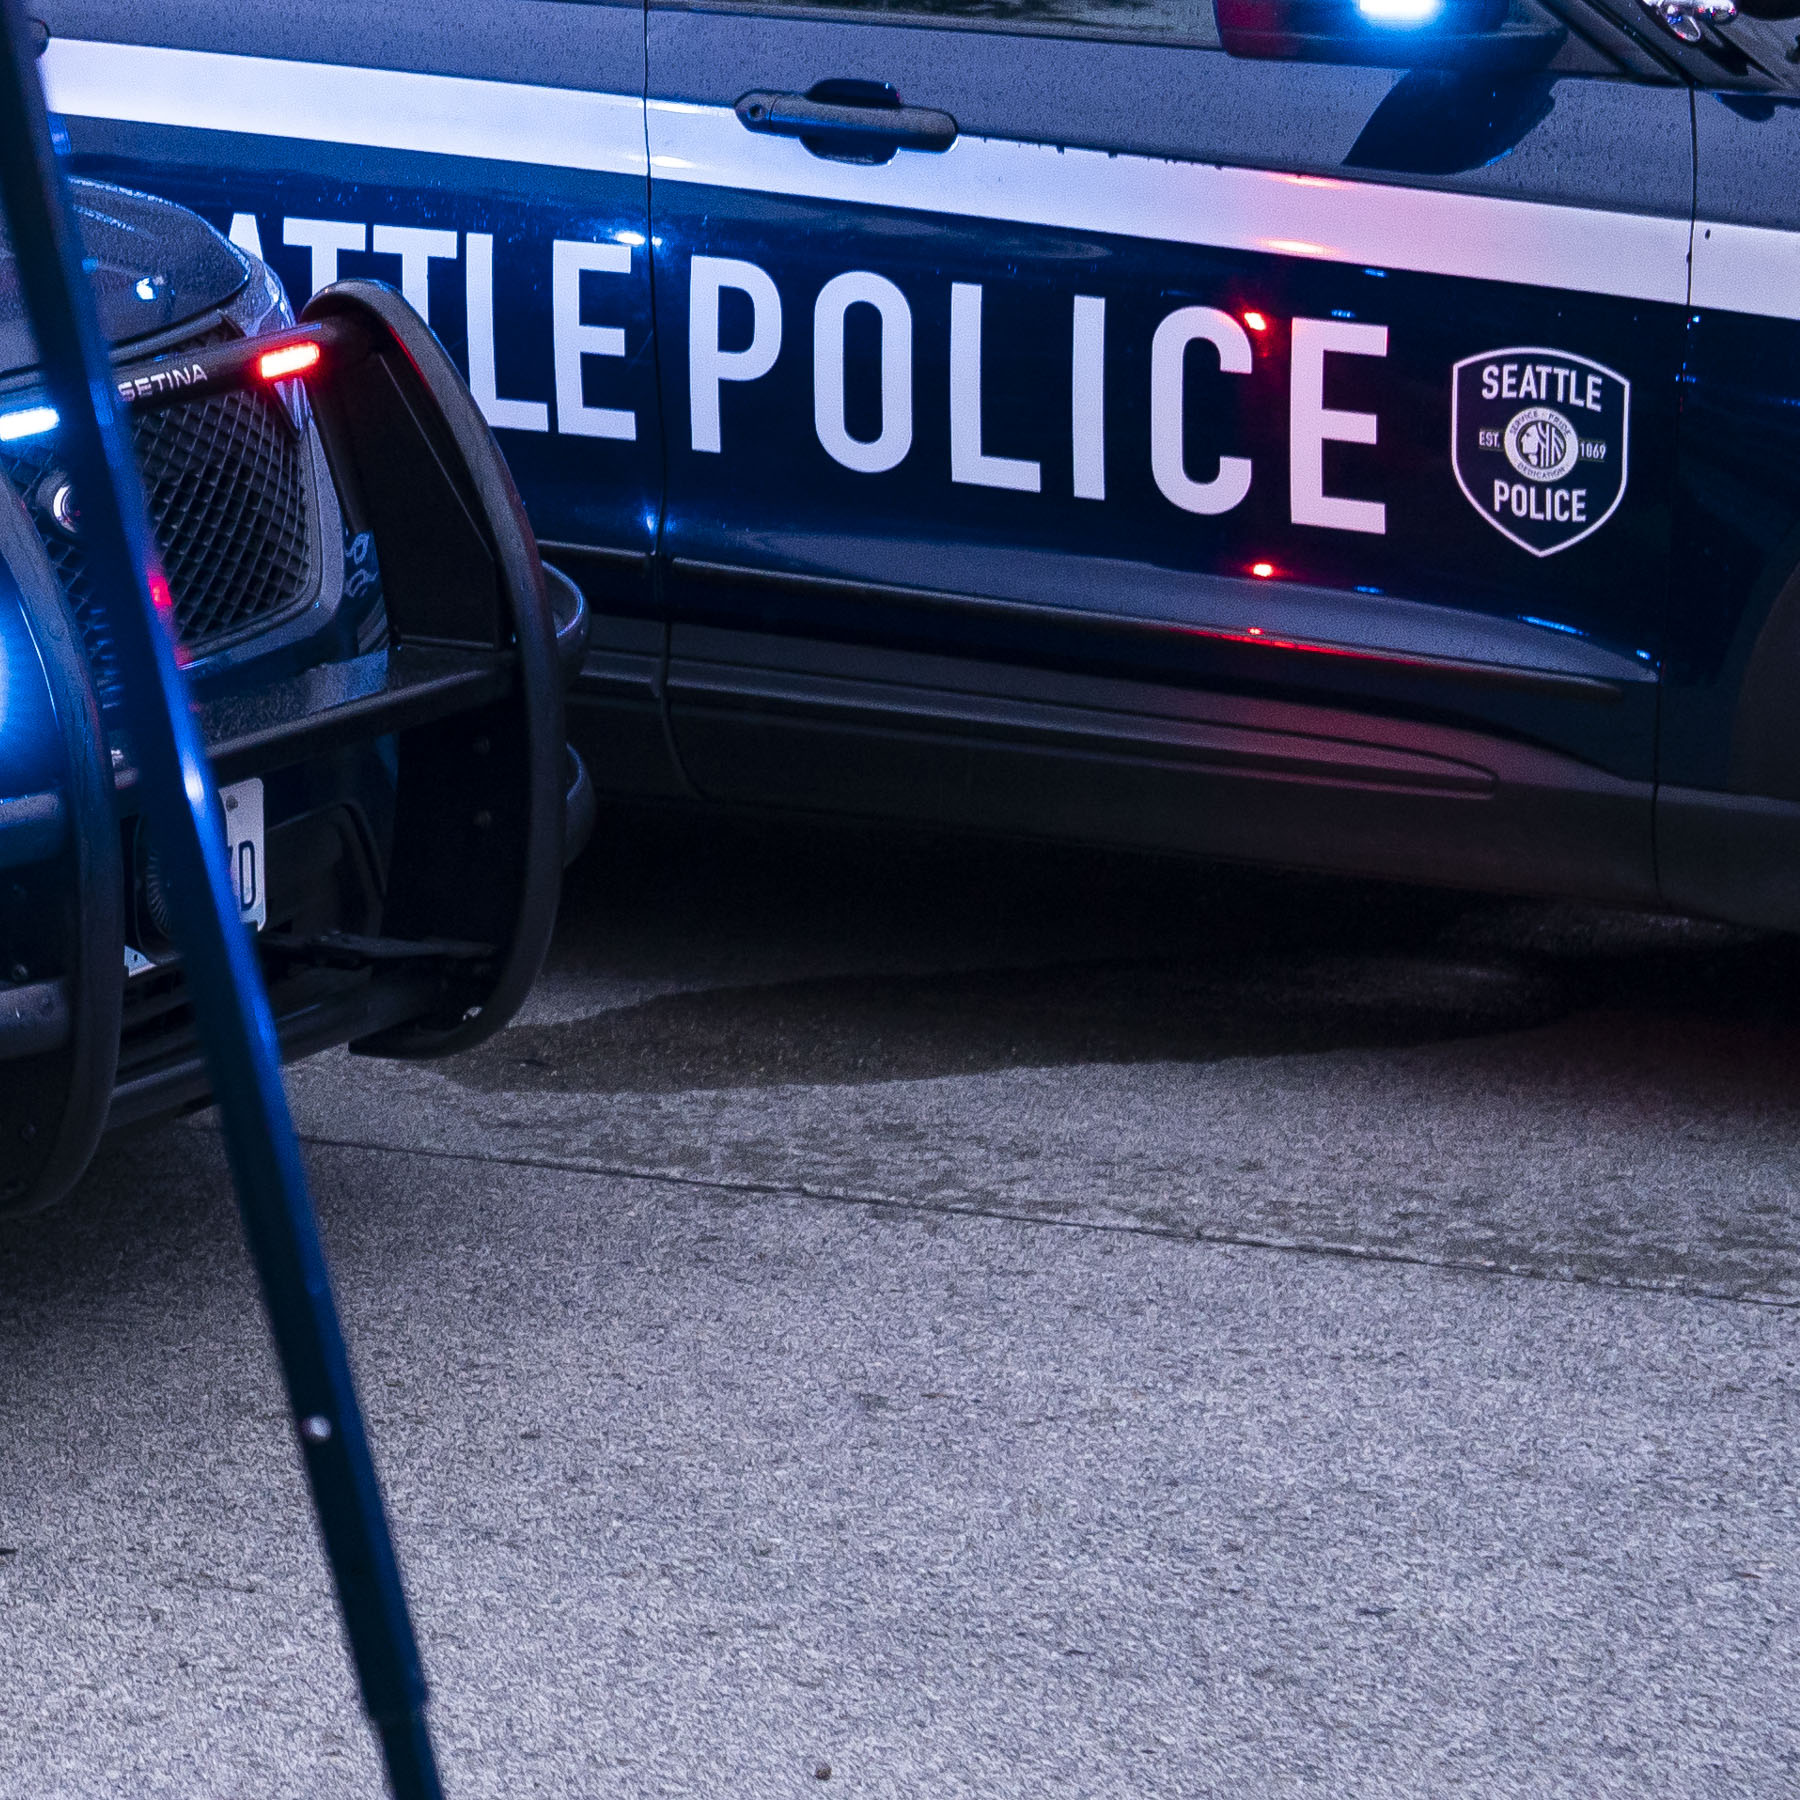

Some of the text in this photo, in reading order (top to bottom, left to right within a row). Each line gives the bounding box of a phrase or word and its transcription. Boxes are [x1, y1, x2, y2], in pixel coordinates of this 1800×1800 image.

[117, 363, 208, 402] SETINA
[688, 255, 1388, 535] POLICE
[1481, 363, 1603, 413] SEATTLE
[1479, 431, 1500, 449] EST.
[1493, 479, 1587, 523] POLICE
